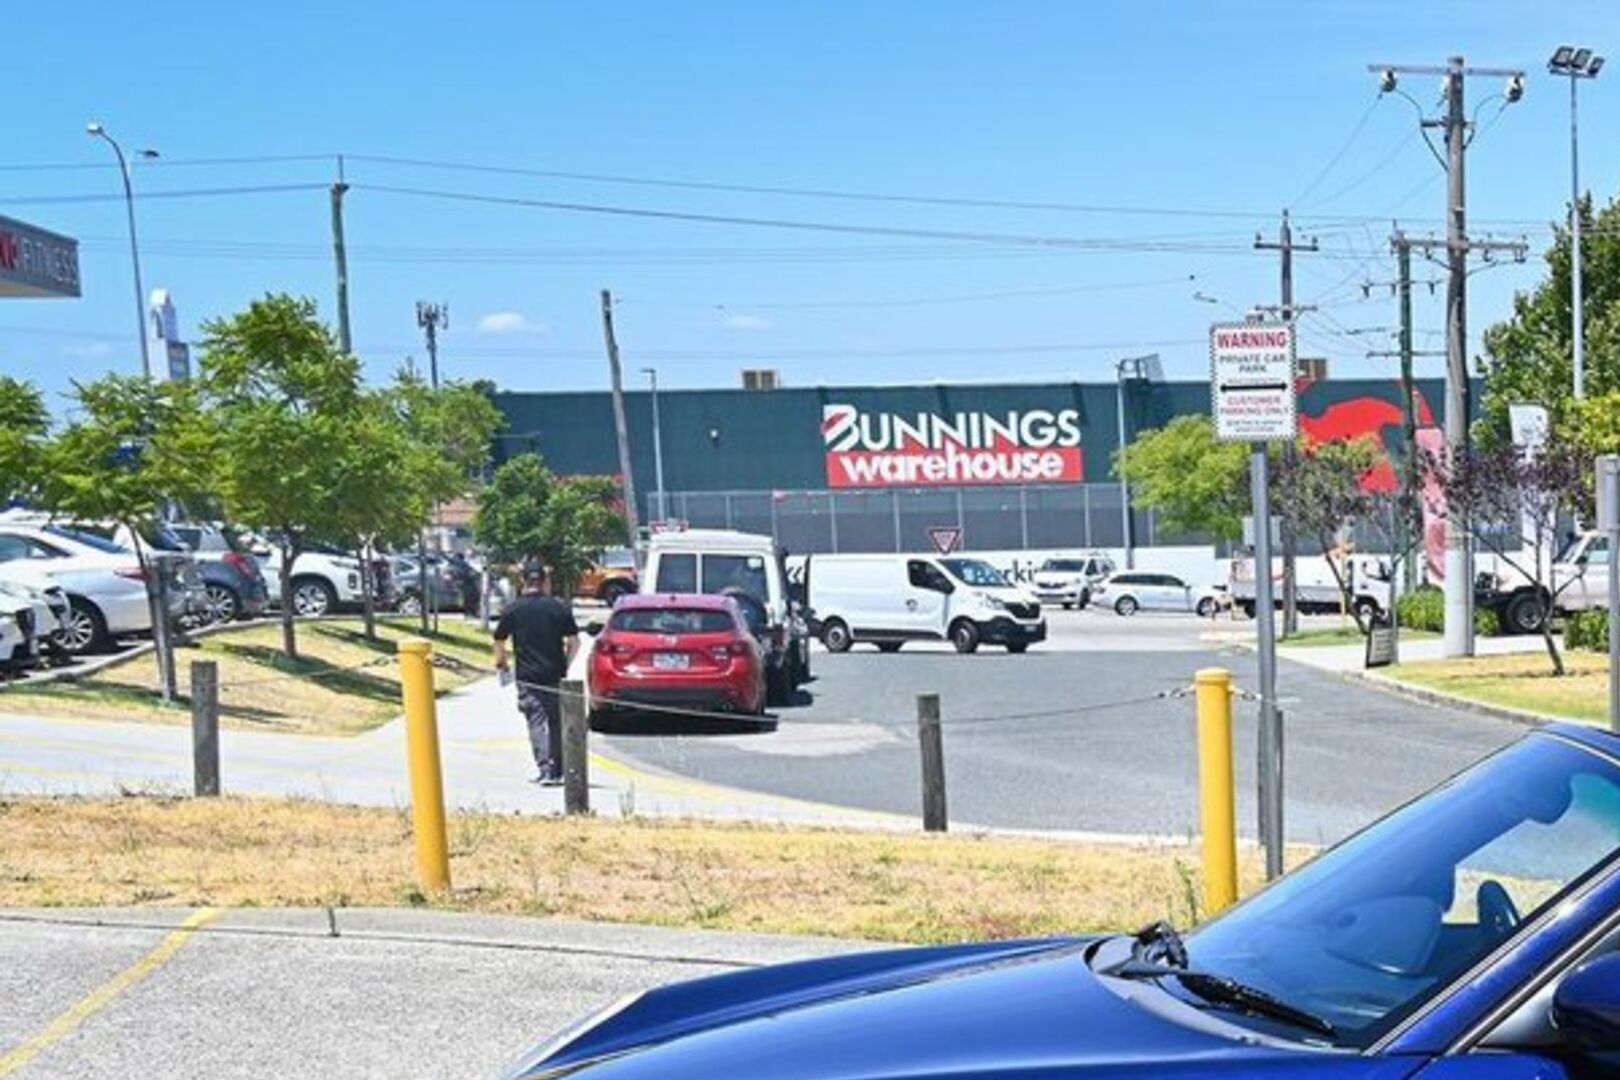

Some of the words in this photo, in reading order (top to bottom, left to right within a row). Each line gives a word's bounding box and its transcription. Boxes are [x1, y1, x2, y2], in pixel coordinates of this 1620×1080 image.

[1217, 331, 1287, 348] WARNING
[1220, 354, 1260, 363] PRIVATE
[1264, 353, 1286, 363] CAR
[1239, 364, 1267, 373] PARK
[1227, 396, 1281, 405] CUSTOMER
[1220, 408, 1261, 417] PARKING
[821, 404, 1082, 452] BUNNINGS
[840, 440, 1065, 483] warehouse
